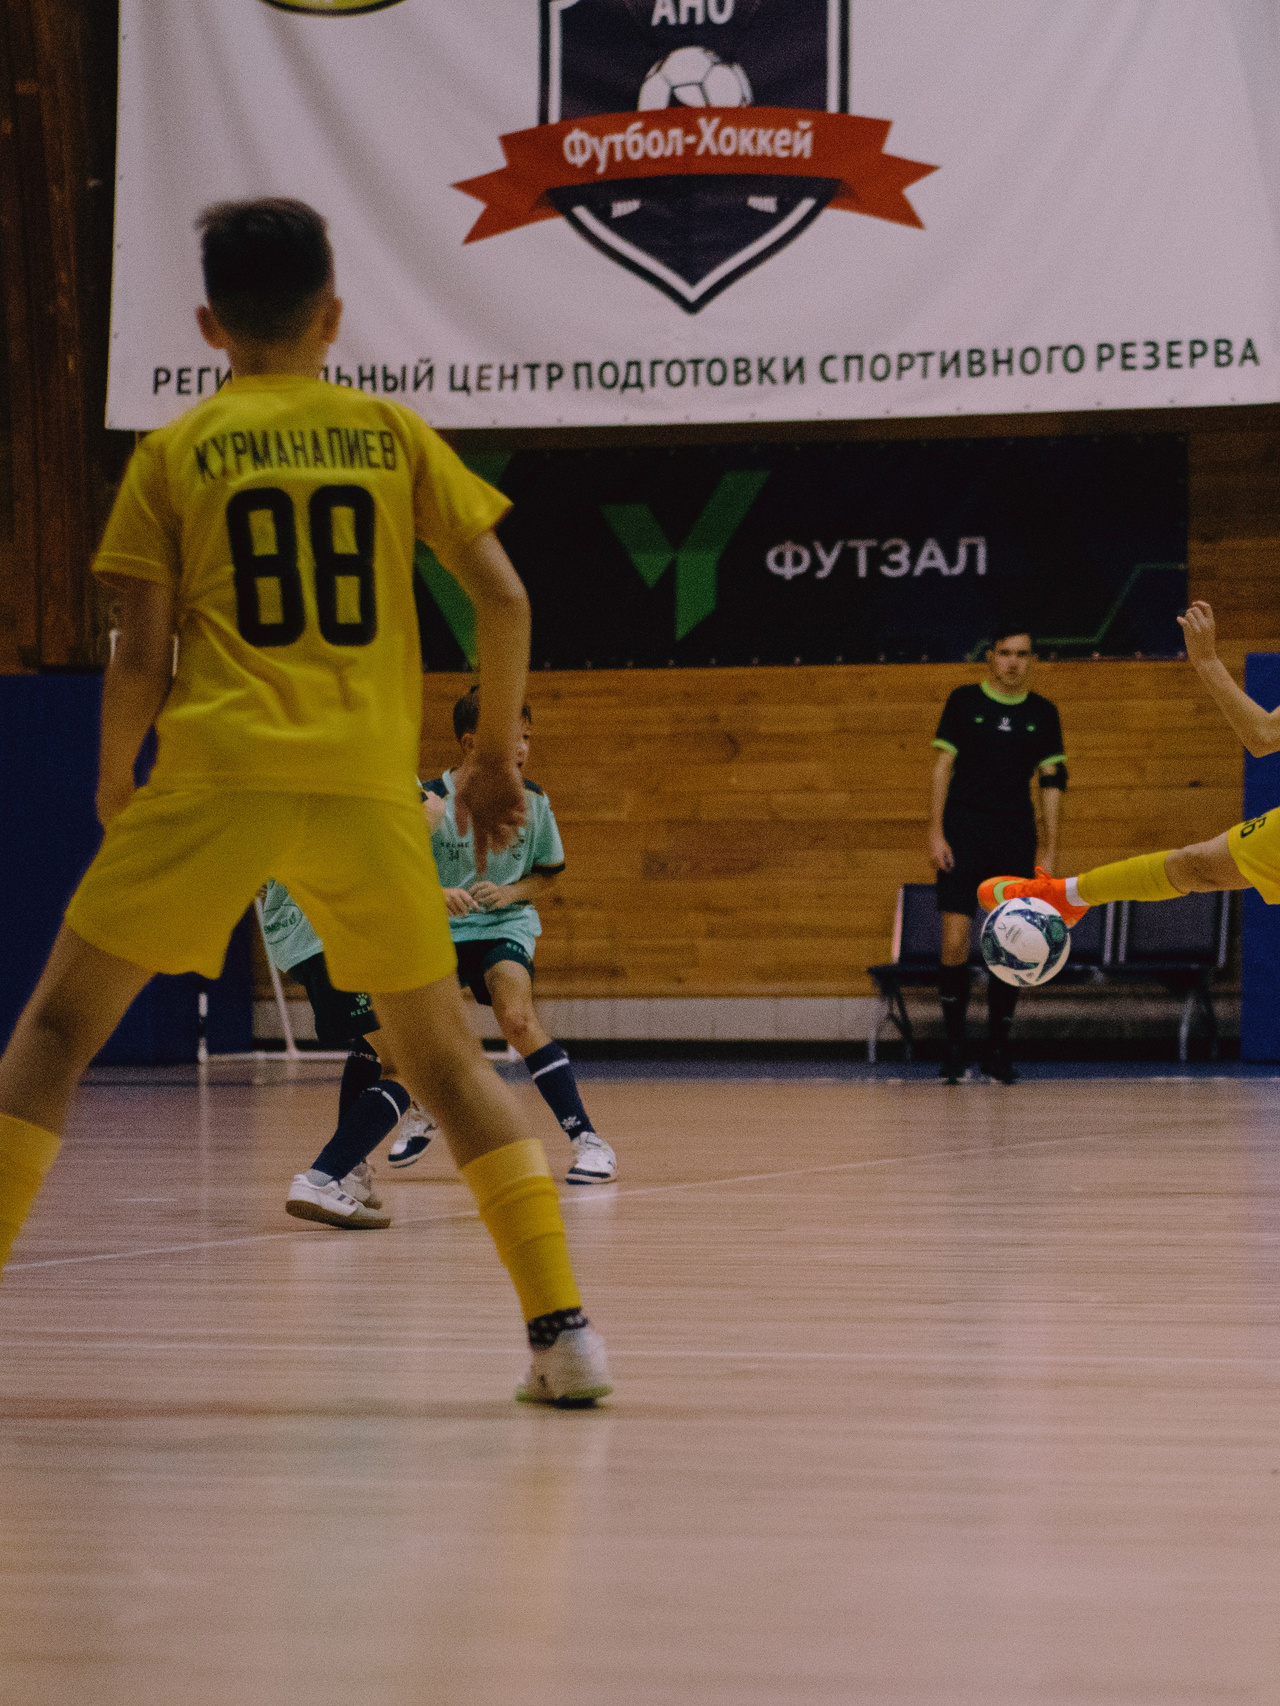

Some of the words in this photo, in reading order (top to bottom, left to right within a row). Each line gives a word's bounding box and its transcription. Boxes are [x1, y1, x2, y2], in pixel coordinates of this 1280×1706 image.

[652, 0, 735, 26] АНО
[563, 117, 814, 174] Футбол-Хоккей
[153, 358, 435, 395] РЕГИЬНЫЙ
[449, 361, 564, 396] ЦЕНТР
[572, 356, 805, 394] ПОДГОТОВКИ
[819, 344, 1086, 383] СПОРТИВНОГО
[1096, 338, 1261, 372] РЕЗЕРВА
[226, 484, 378, 648] 88
[765, 537, 986, 580] ФУТЗАЛ
